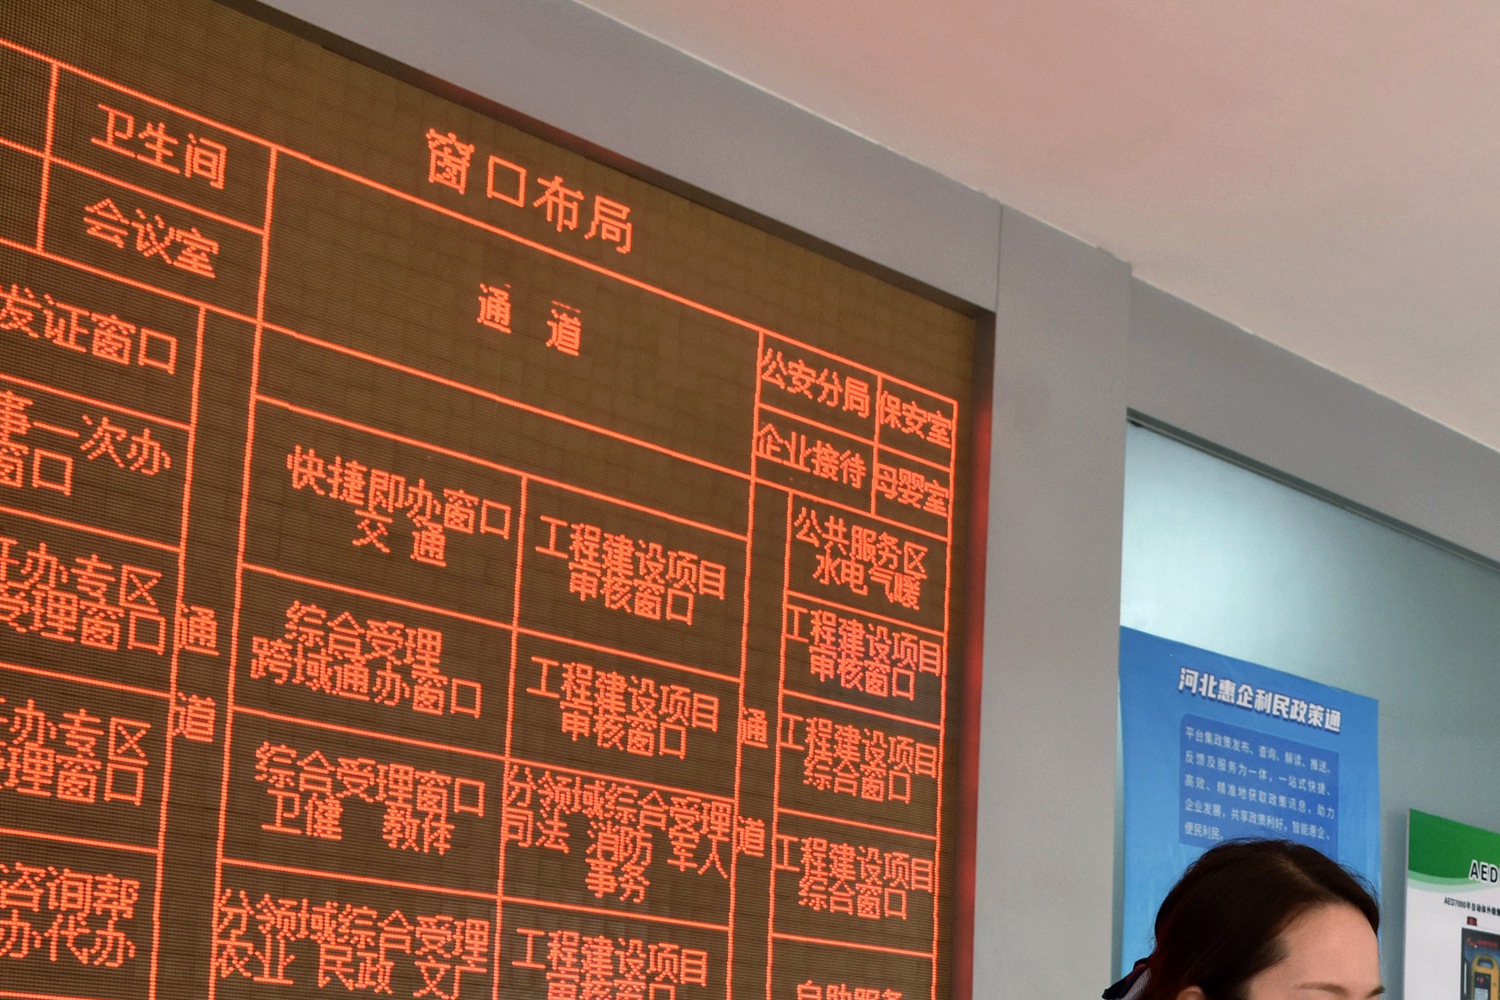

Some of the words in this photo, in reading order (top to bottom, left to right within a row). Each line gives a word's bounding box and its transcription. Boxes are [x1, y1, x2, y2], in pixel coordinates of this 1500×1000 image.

[90, 103, 227, 190] 卫生间
[426, 128, 633, 254] 窗口布局
[84, 197, 219, 278] 会议室
[0, 283, 178, 375] 发证窗口
[477, 283, 582, 357] 通道
[760, 347, 870, 419] 公安分局
[878, 390, 952, 449] 保安室
[756, 422, 867, 489] 企业接待
[874, 462, 950, 518] 母婴室
[286, 444, 511, 539] 快捷即办窗口
[352, 508, 447, 568] 交通
[535, 514, 727, 600] 工程建设项目
[794, 506, 929, 578] 公共服务区
[568, 559, 694, 625] 审核窗口
[812, 549, 921, 611] 水电气暖
[284, 600, 443, 674] 综合受理
[784, 607, 942, 677] 工程建设项目
[808, 642, 916, 700] 审核窗口
[250, 635, 483, 718] 跨域通办窗口
[527, 655, 719, 732] 工程建设项目
[1178, 668, 1342, 733] 河北惠企利民政策通
[558, 698, 687, 760] 审核窗口
[778, 711, 938, 779] 工程建设项目
[255, 741, 485, 818] 综合受理窗口
[505, 765, 733, 842] 分领域综合受理
[802, 748, 912, 804] 综合窗口
[261, 789, 344, 840] 卫健
[382, 800, 456, 856] 教体
[503, 807, 570, 854] 司法
[585, 820, 653, 868] 消防
[666, 826, 729, 879] 军人
[584, 857, 651, 903] 事务
[774, 833, 934, 893] 工程建设项目
[216, 888, 491, 973] 分领域综合受理
[797, 877, 908, 921] 综合窗口
[213, 932, 295, 987] 农业
[317, 943, 395, 996] 民政
[512, 927, 708, 987] 工程建设项目
